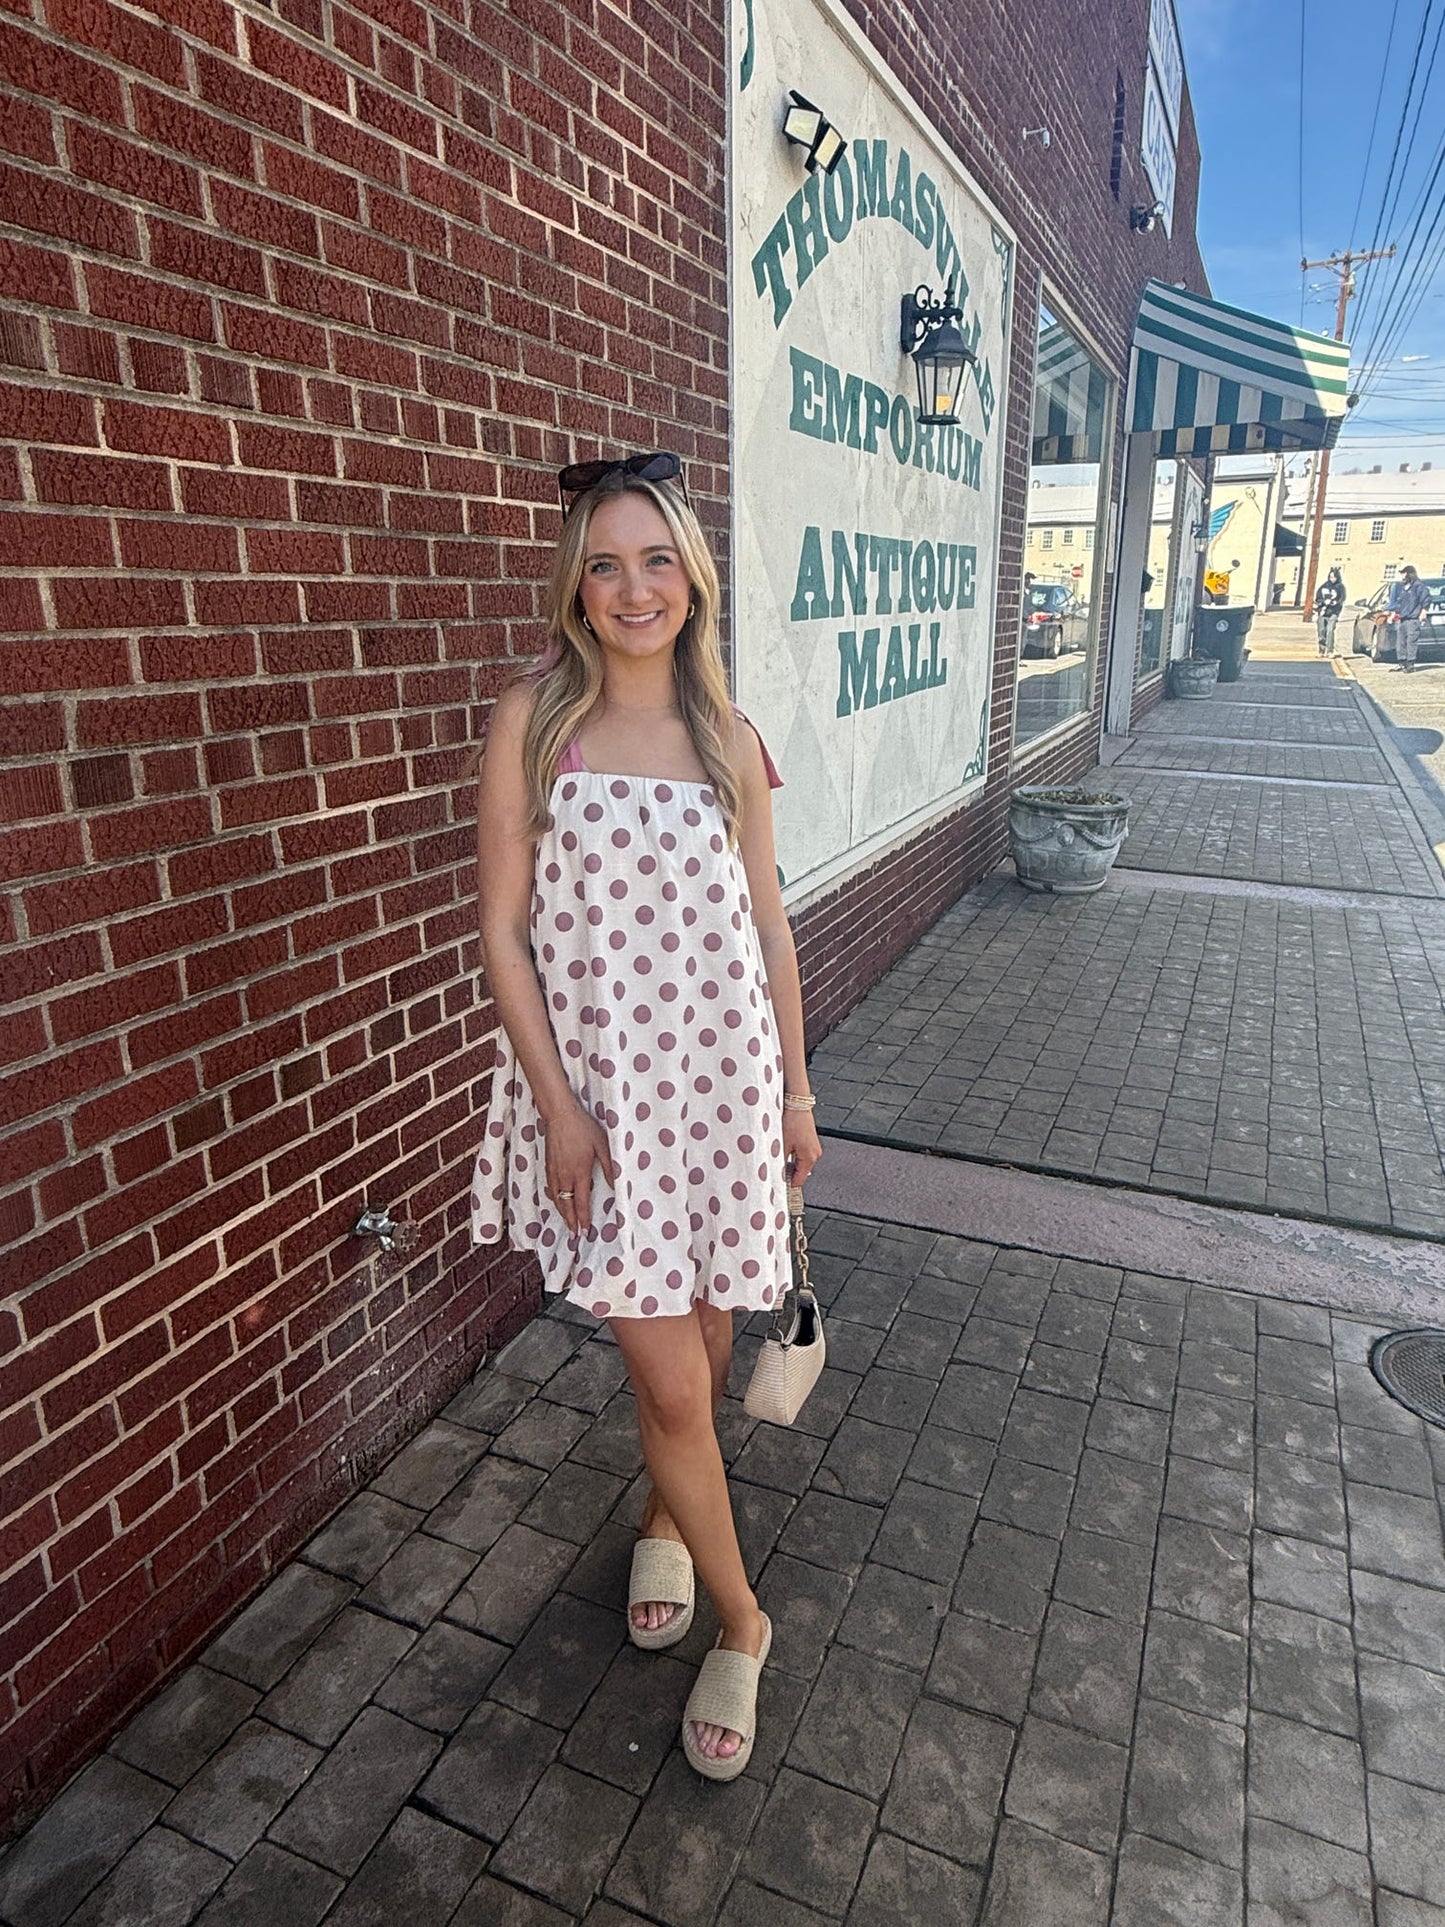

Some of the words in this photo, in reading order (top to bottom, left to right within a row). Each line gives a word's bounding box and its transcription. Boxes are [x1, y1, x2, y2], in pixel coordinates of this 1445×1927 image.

[751, 139, 996, 436] THOMASVILLE
[789, 346, 983, 492] EMPORIUM
[791, 526, 978, 621] ANTIQUE
[836, 622, 947, 718] MALL
